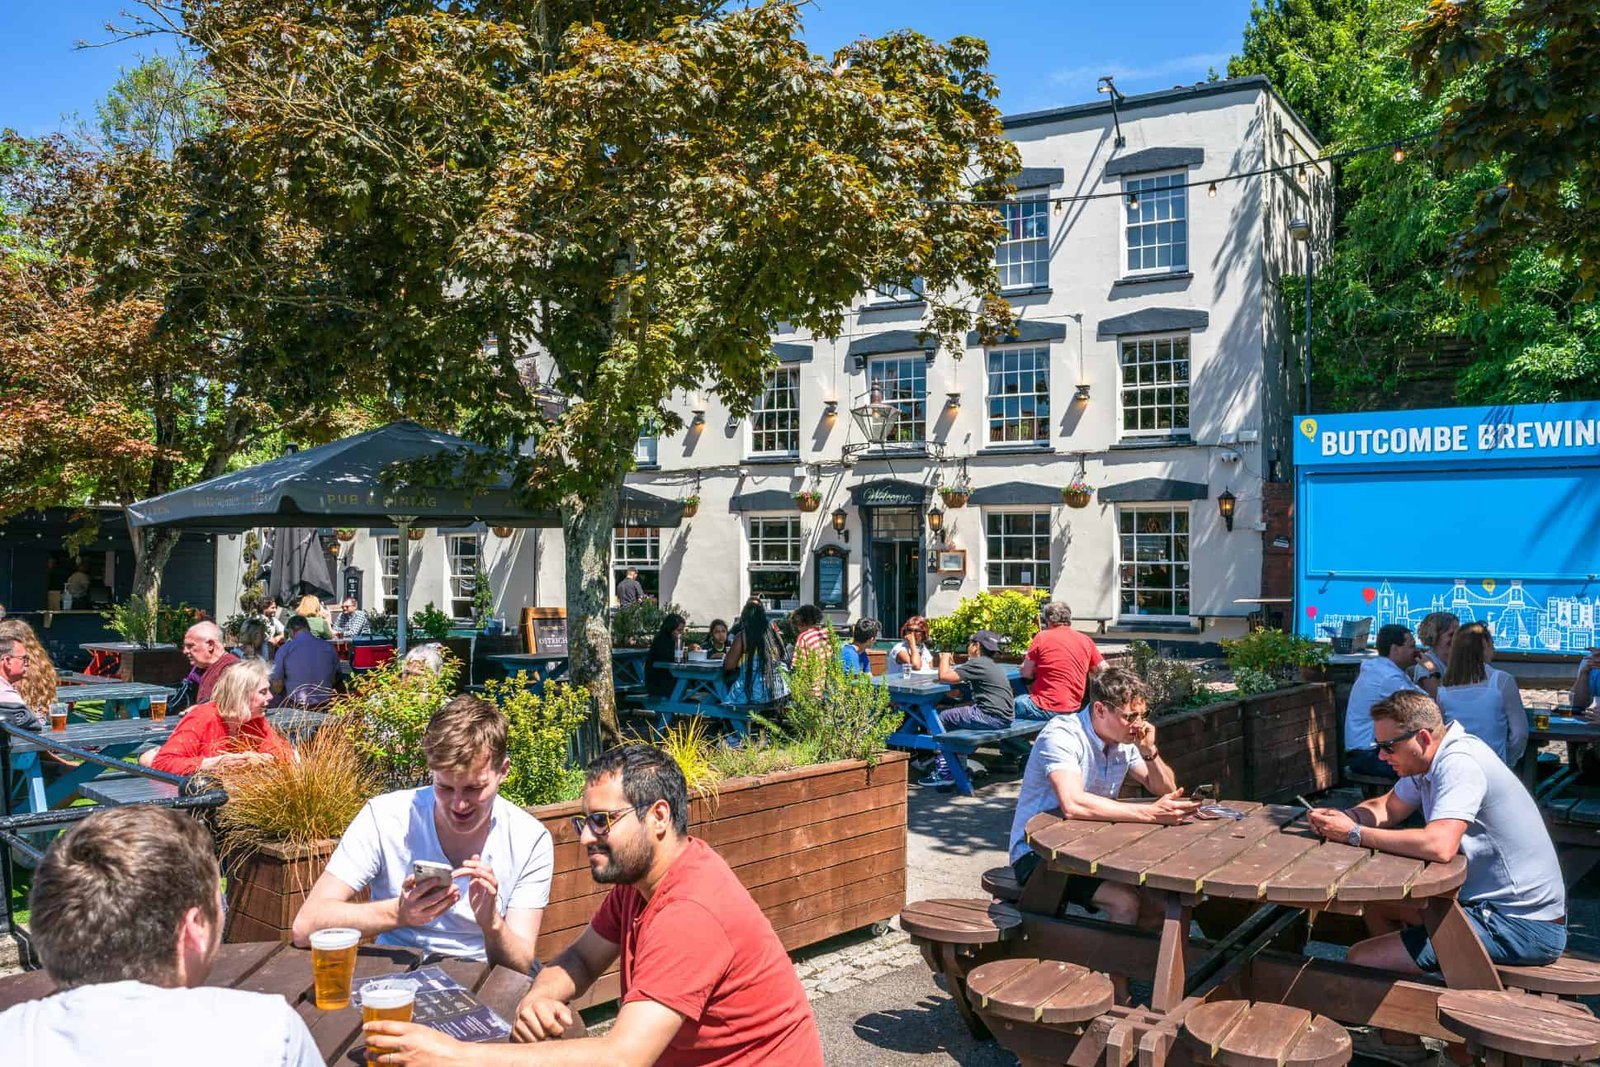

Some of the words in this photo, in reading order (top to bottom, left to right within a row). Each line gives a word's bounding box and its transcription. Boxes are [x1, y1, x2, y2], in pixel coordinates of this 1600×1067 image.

[1321, 425, 1468, 456] BUTCOMBE
[1478, 419, 1600, 450] BREWIN
[326, 494, 358, 505] PUB
[863, 485, 914, 502] Welcome
